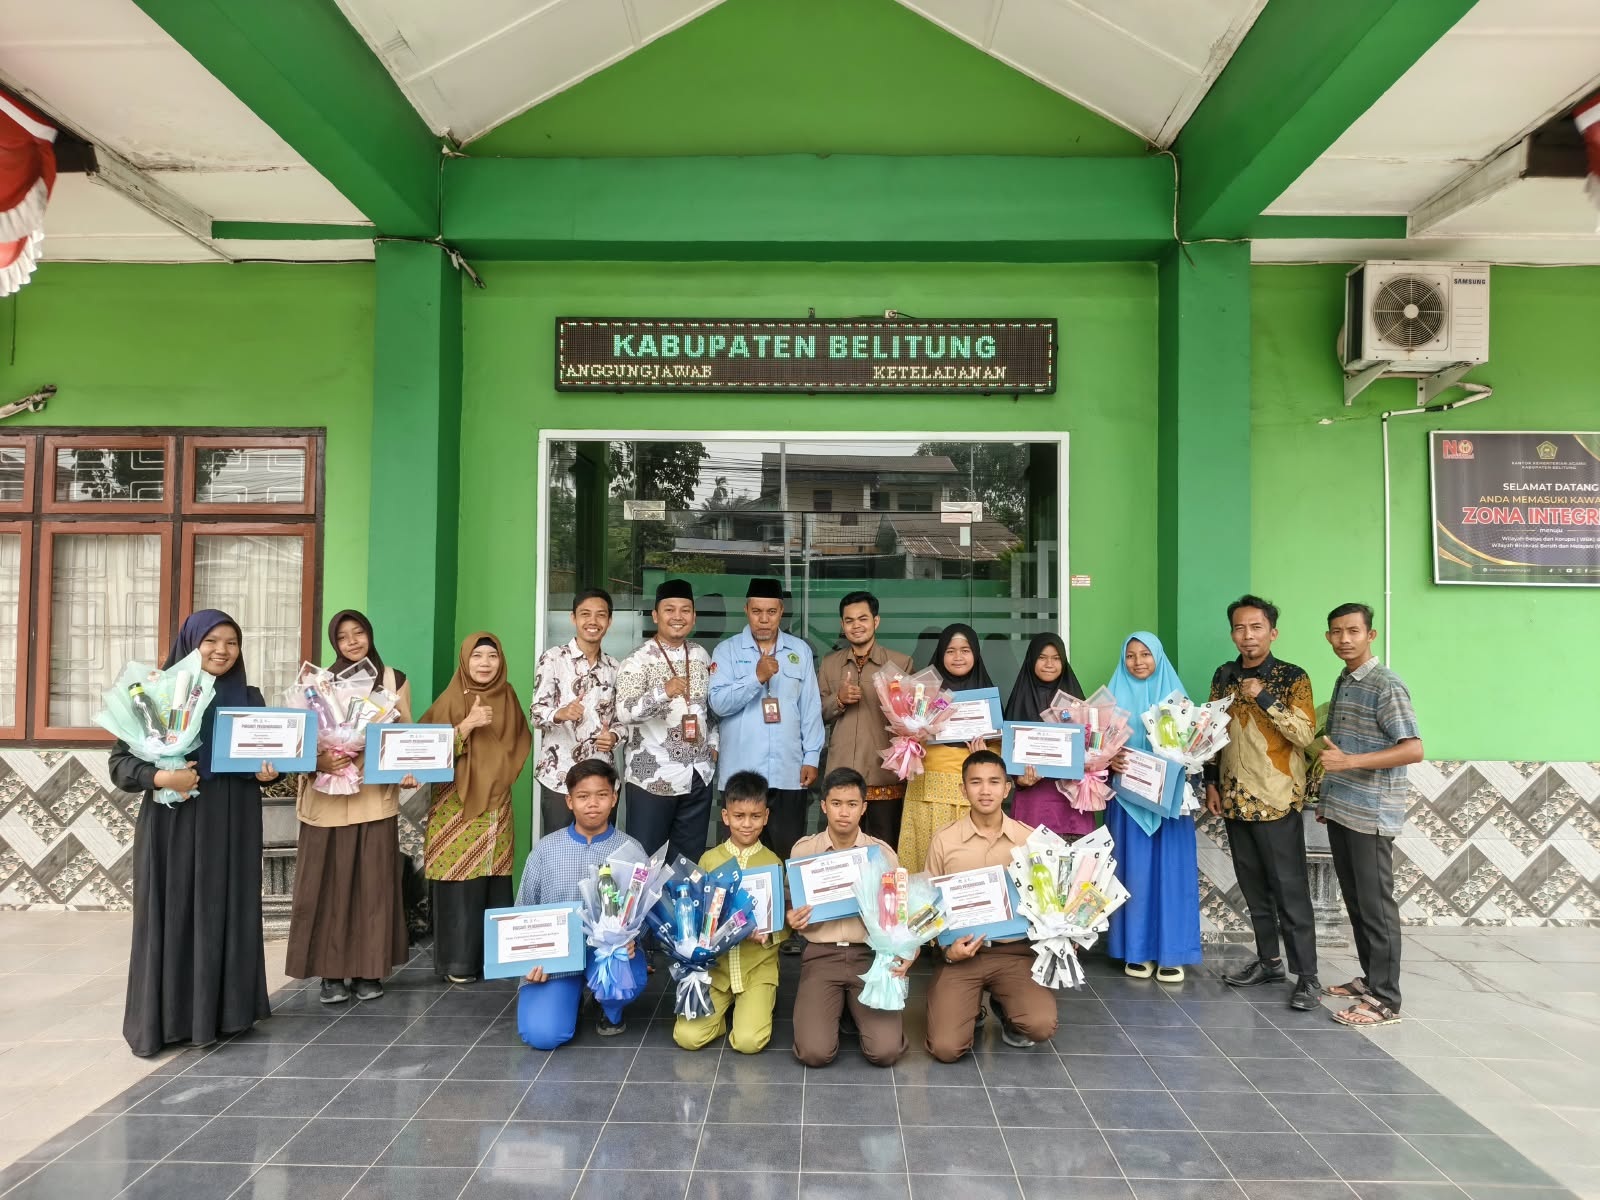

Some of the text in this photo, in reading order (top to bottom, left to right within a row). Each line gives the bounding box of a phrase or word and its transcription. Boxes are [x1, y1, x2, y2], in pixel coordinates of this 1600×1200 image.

[613, 334, 996, 359] KABUPATEN BELITUNG
[561, 364, 712, 379] ANGGUNGJAWAB
[873, 366, 1007, 379] KETELADANAN
[1503, 482, 1599, 492] SELAMAT DATANG
[1479, 495, 1510, 503] ANDA
[1512, 496, 1568, 504] MEMASUKI
[1462, 506, 1600, 526] ZONA INTEGR
